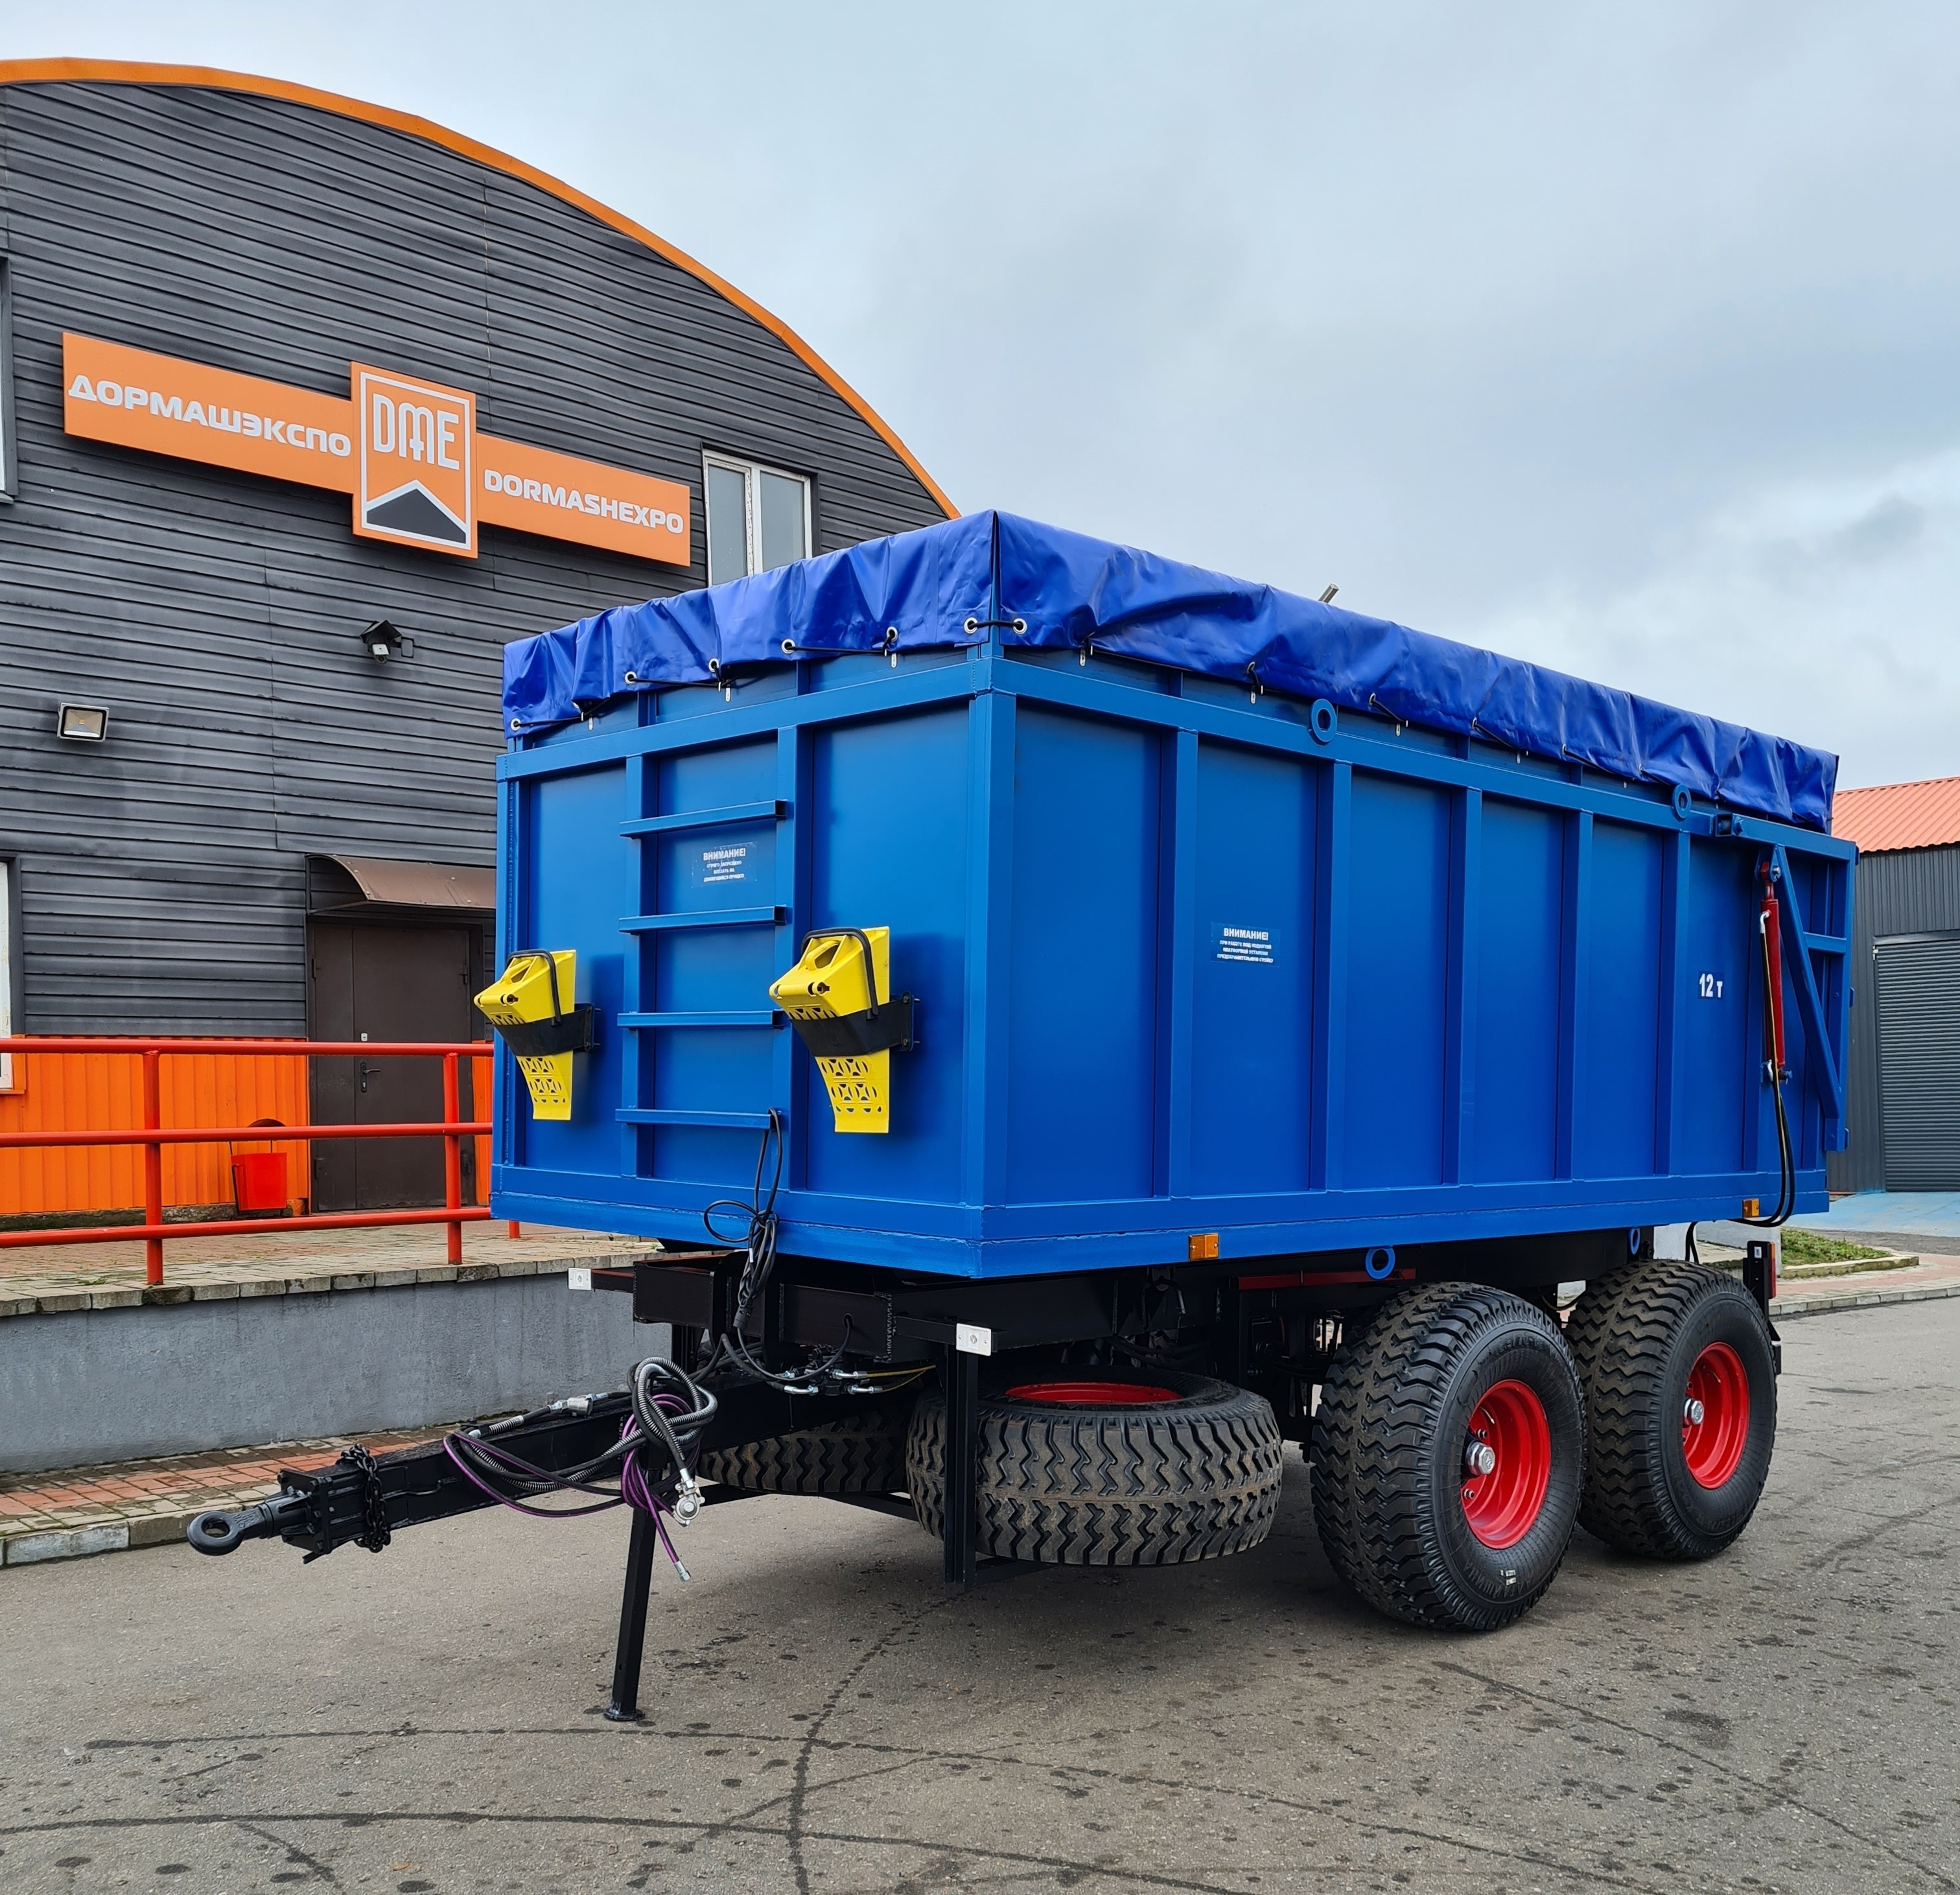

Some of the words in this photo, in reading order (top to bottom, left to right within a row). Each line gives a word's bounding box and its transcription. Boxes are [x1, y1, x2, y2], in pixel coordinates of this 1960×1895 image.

[68, 375, 351, 457] ДОРМАШЭКСПО
[372, 393, 460, 471] DME
[484, 469, 684, 534] DORMASHEXPO
[703, 848, 746, 861] ВНИМАНИЕ!
[1224, 928, 1268, 941] ВНИМАНИЕ!
[1699, 973, 1714, 998] 12
